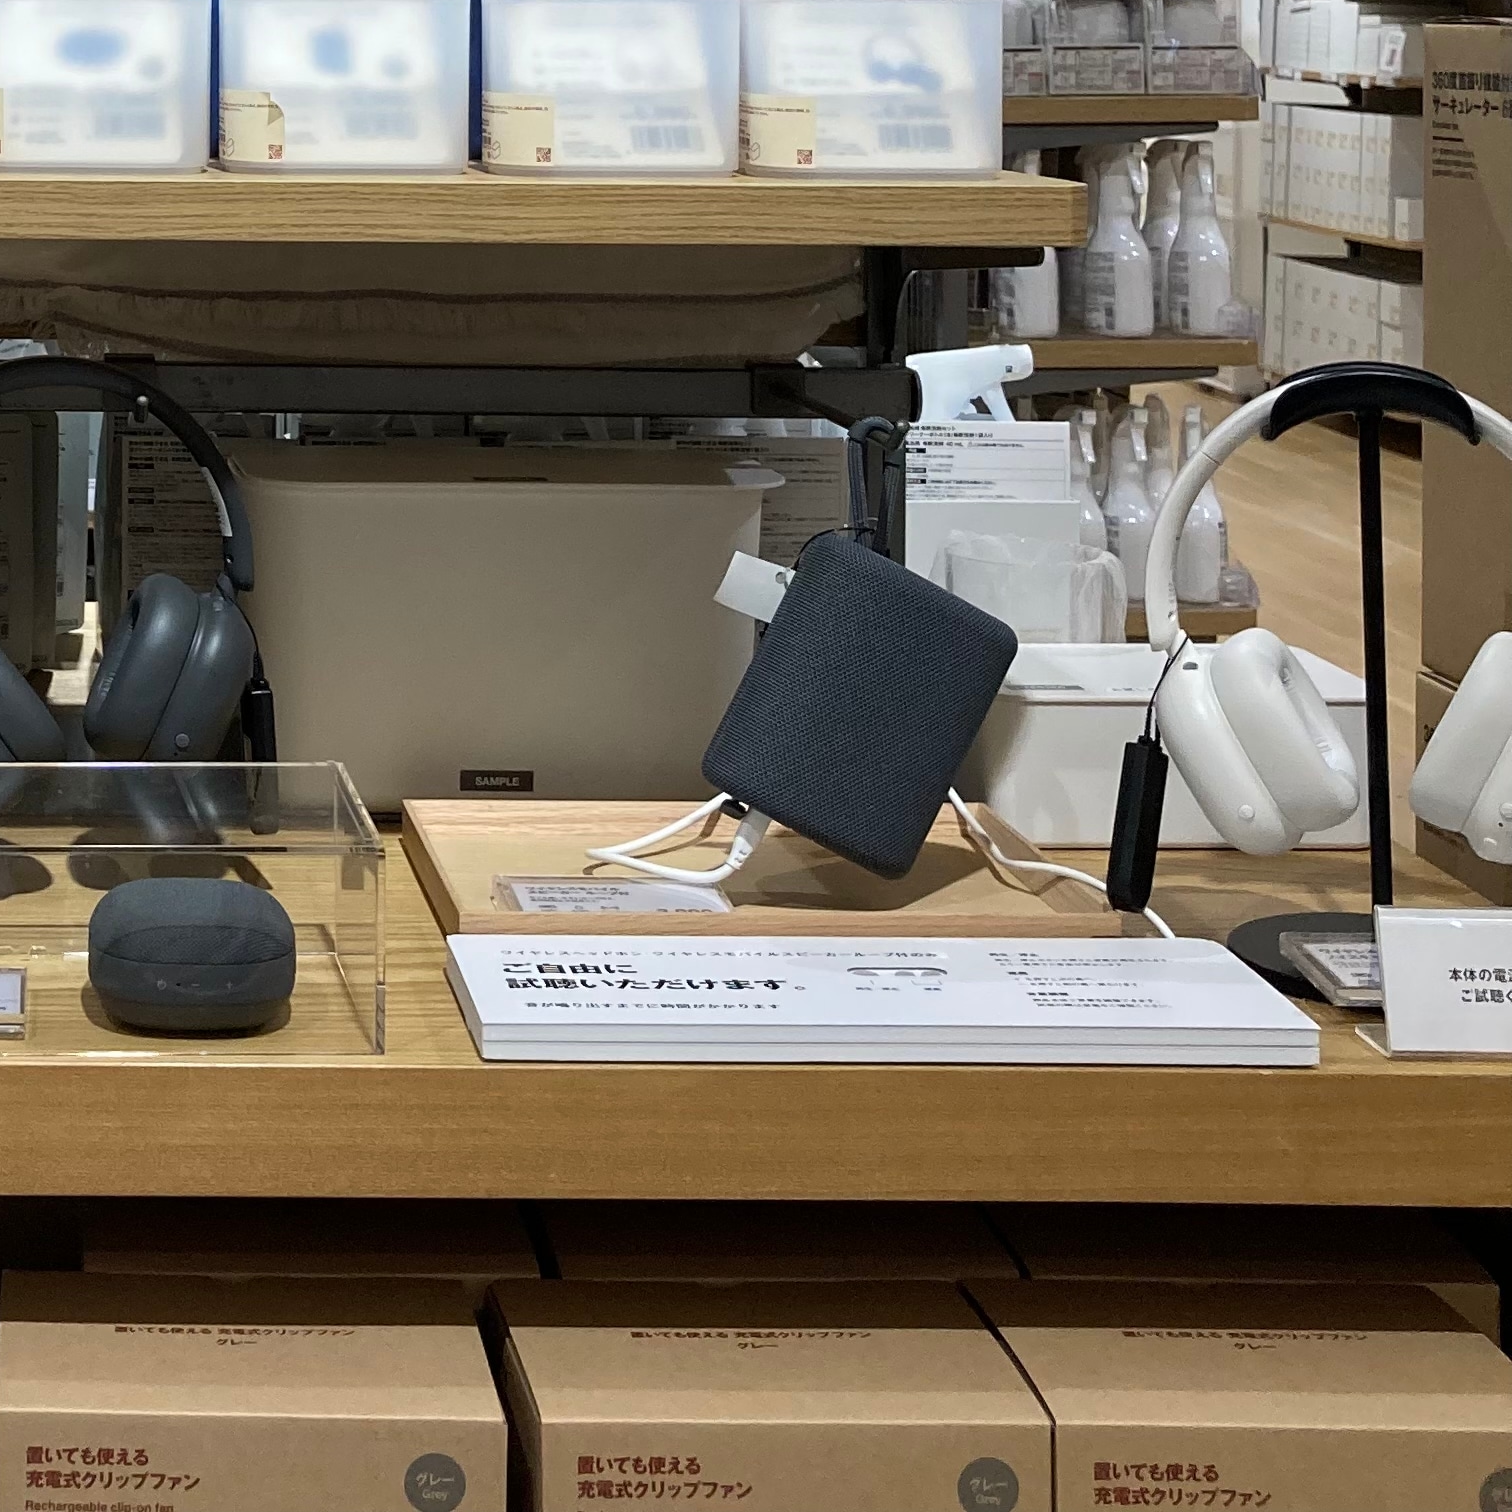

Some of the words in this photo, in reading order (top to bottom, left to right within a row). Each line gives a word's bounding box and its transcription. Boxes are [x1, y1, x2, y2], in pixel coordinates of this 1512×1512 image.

[474, 776, 520, 787] SAMPLE
[502, 962, 638, 975] ご自由に
[505, 977, 806, 991] 試聴いただけます。
[25, 1446, 149, 1466] 置いても使える
[577, 1455, 701, 1475] 置いても使える
[25, 1470, 201, 1491] 充電式クリップファン
[415, 1472, 455, 1487] グレー
[1094, 1462, 1219, 1483] 置いても使える
[577, 1480, 753, 1500] 充電式クリップファン
[1093, 1487, 1272, 1507] 充電式クリップファン
[25, 1500, 108, 1512] Rechargeable
[110, 1501, 152, 1512] clip-on
[155, 1502, 174, 1512] fan
